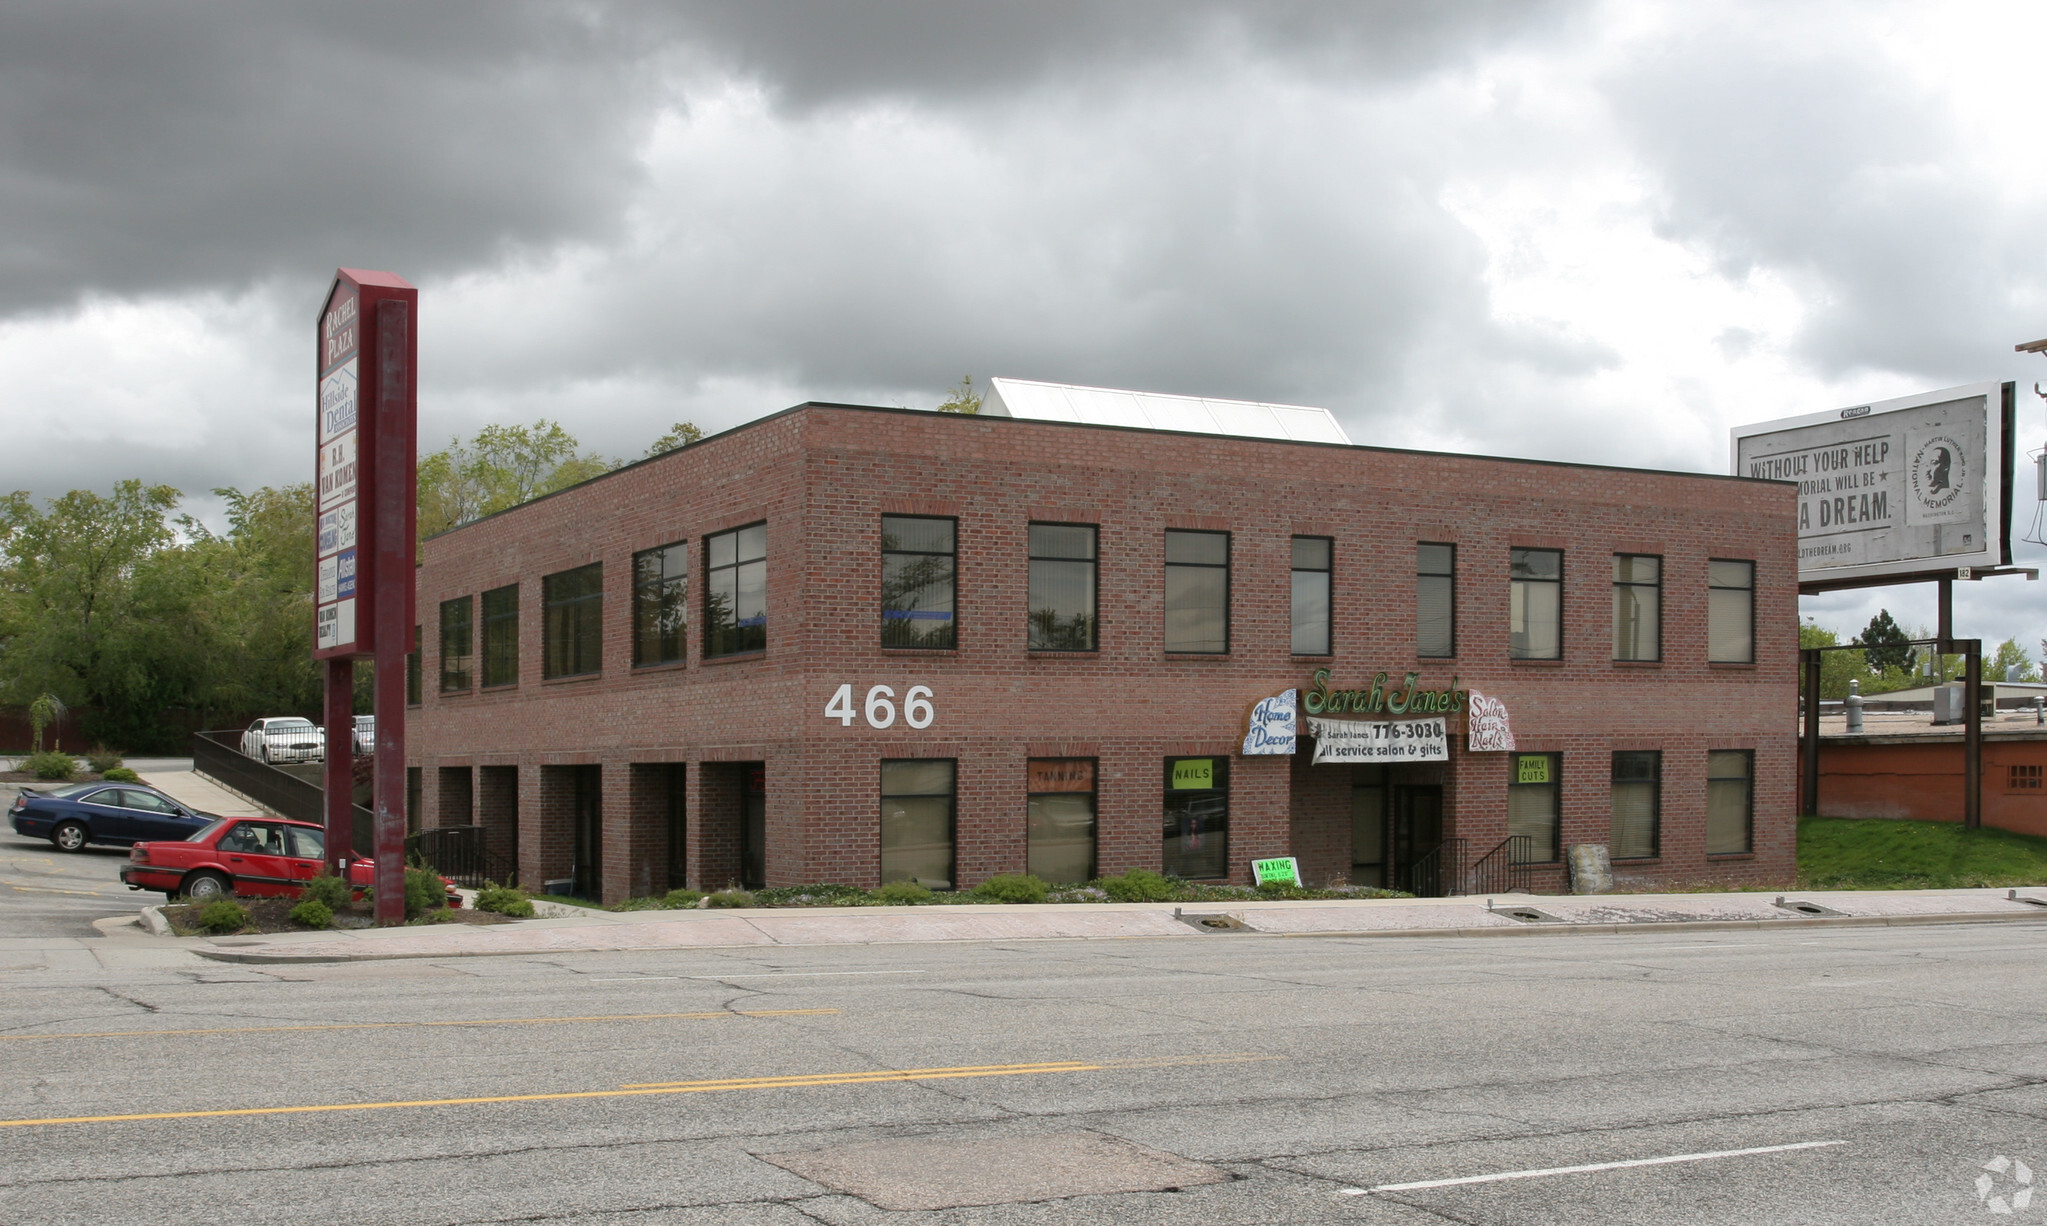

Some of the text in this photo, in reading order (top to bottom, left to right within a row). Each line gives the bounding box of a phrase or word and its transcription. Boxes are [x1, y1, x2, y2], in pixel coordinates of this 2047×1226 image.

[326, 297, 356, 339] RACHEL
[328, 328, 353, 365] PLAZA
[322, 383, 349, 413] Hillside
[327, 390, 357, 434] Dental
[1924, 436, 1943, 448] MARTIN
[1943, 436, 1961, 452] LUTHER
[1751, 442, 1889, 479] WITHOUT YOUR HELP
[321, 472, 334, 495] VAN
[1798, 471, 1875, 496] MORIAL WILL BE
[1911, 449, 1924, 502] NATIONAL
[1923, 482, 1964, 509] MEMORIAL
[1799, 491, 1891, 530] A DREAM.
[1798, 543, 1851, 559] LDTHEDREAM.ORG
[1304, 667, 1466, 715] Sarah Jane's
[824, 683, 935, 730] 466
[1254, 698, 1291, 728] Home
[1471, 696, 1507, 719] Salon
[1252, 725, 1294, 748] Decor
[1328, 731, 1349, 739] Sarah
[1470, 717, 1500, 733] Hair
[1335, 745, 1373, 757] service
[1377, 743, 1405, 756] salon
[1408, 745, 1417, 755] &
[1421, 744, 1442, 758] gifts
[1471, 730, 1505, 750] Nails
[1037, 770, 1084, 782] TANNING
[1175, 768, 1210, 780] NAILS
[1520, 760, 1546, 770] FAMILY
[1522, 771, 1545, 781] CUTS
[1257, 860, 1292, 871] WAXING
